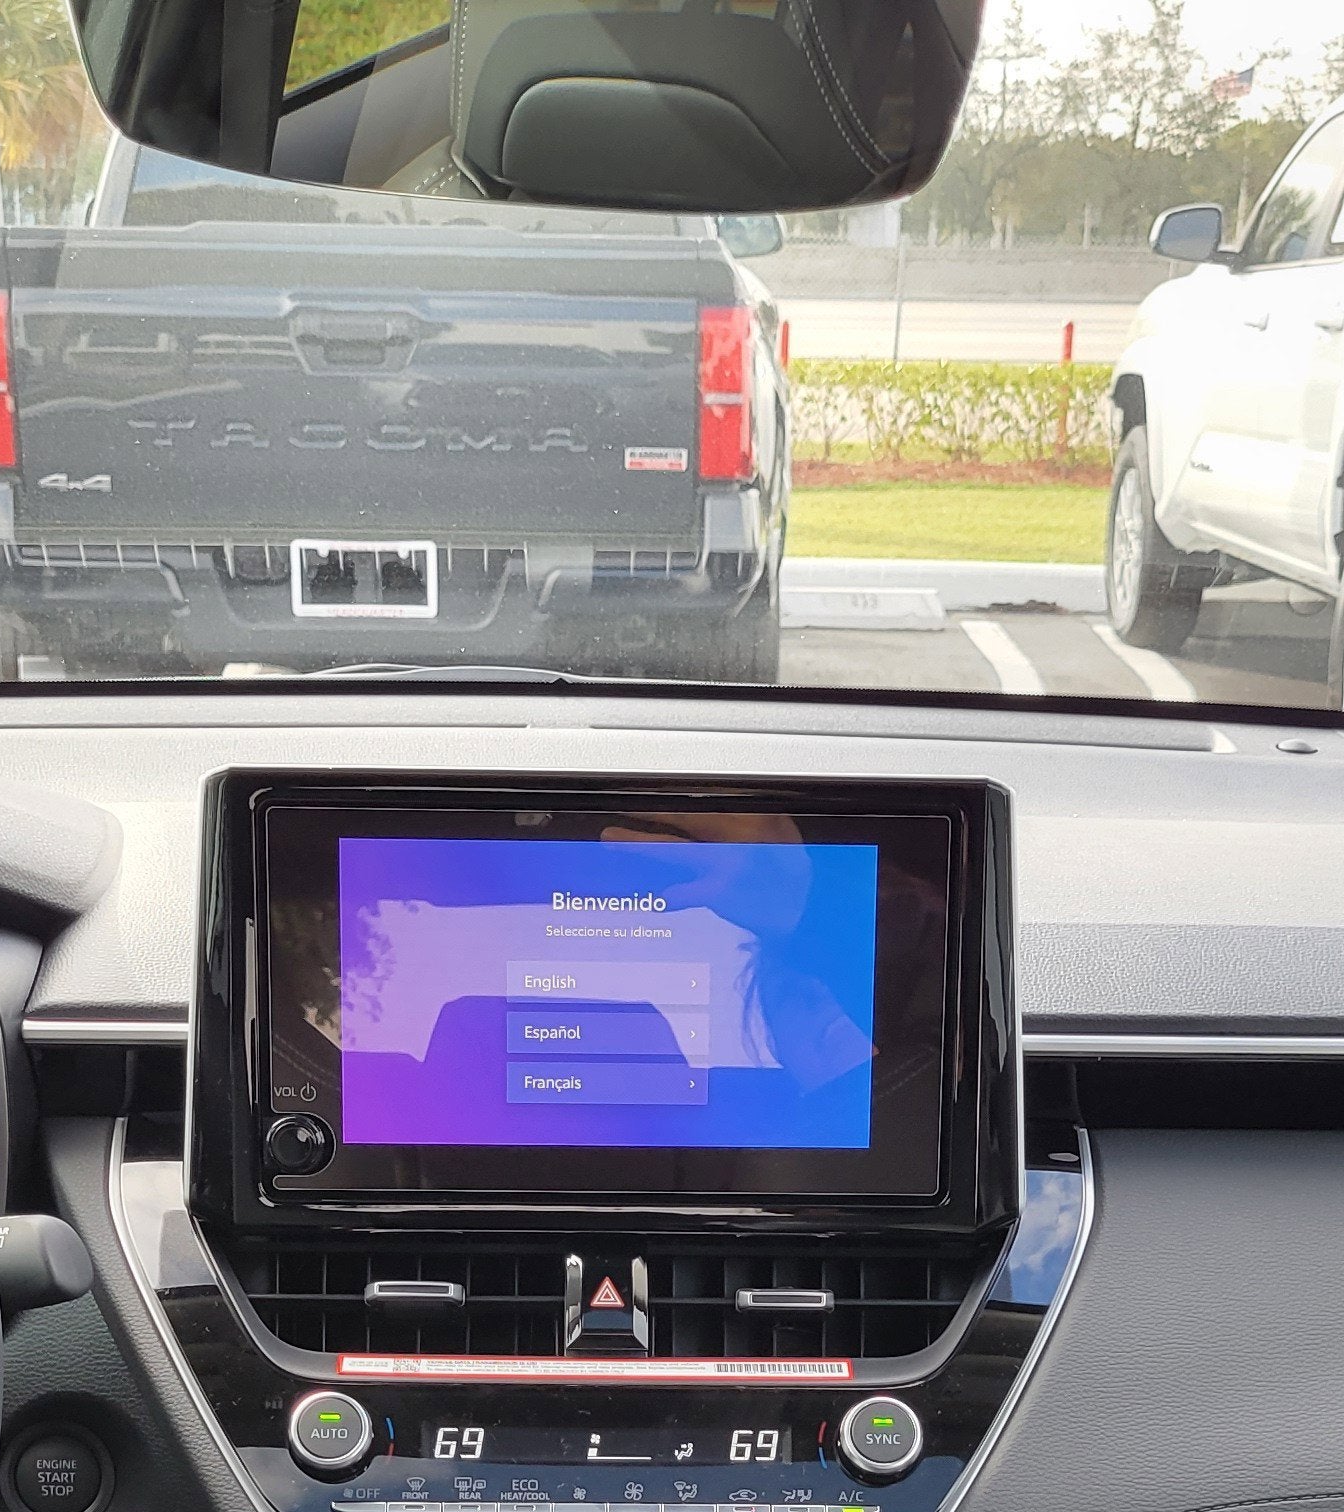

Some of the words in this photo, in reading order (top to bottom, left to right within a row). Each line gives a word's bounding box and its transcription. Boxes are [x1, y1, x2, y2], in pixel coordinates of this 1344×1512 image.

[127, 419, 589, 454] TACOMA
[552, 892, 667, 912] Bienvenido
[546, 925, 611, 937] Seleccione
[614, 928, 627, 938] su
[631, 927, 672, 938] idioma
[524, 975, 576, 991] English
[524, 1025, 581, 1042] Español
[524, 1076, 582, 1093] Français
[273, 1086, 297, 1097] VOL
[310, 1428, 348, 1440] AUTO
[865, 1433, 901, 1445] SYNC
[434, 1427, 485, 1459] 69
[729, 1429, 779, 1461] 69
[36, 1459, 77, 1469] ENGINE
[37, 1471, 76, 1483] START
[41, 1485, 74, 1496] STOP
[512, 1479, 538, 1491] ECO
[356, 1488, 381, 1499] OFF
[401, 1491, 429, 1500] FRONT
[459, 1491, 481, 1500] REAR
[500, 1491, 551, 1501] HEAT/COOL
[838, 1490, 864, 1502] A/C
